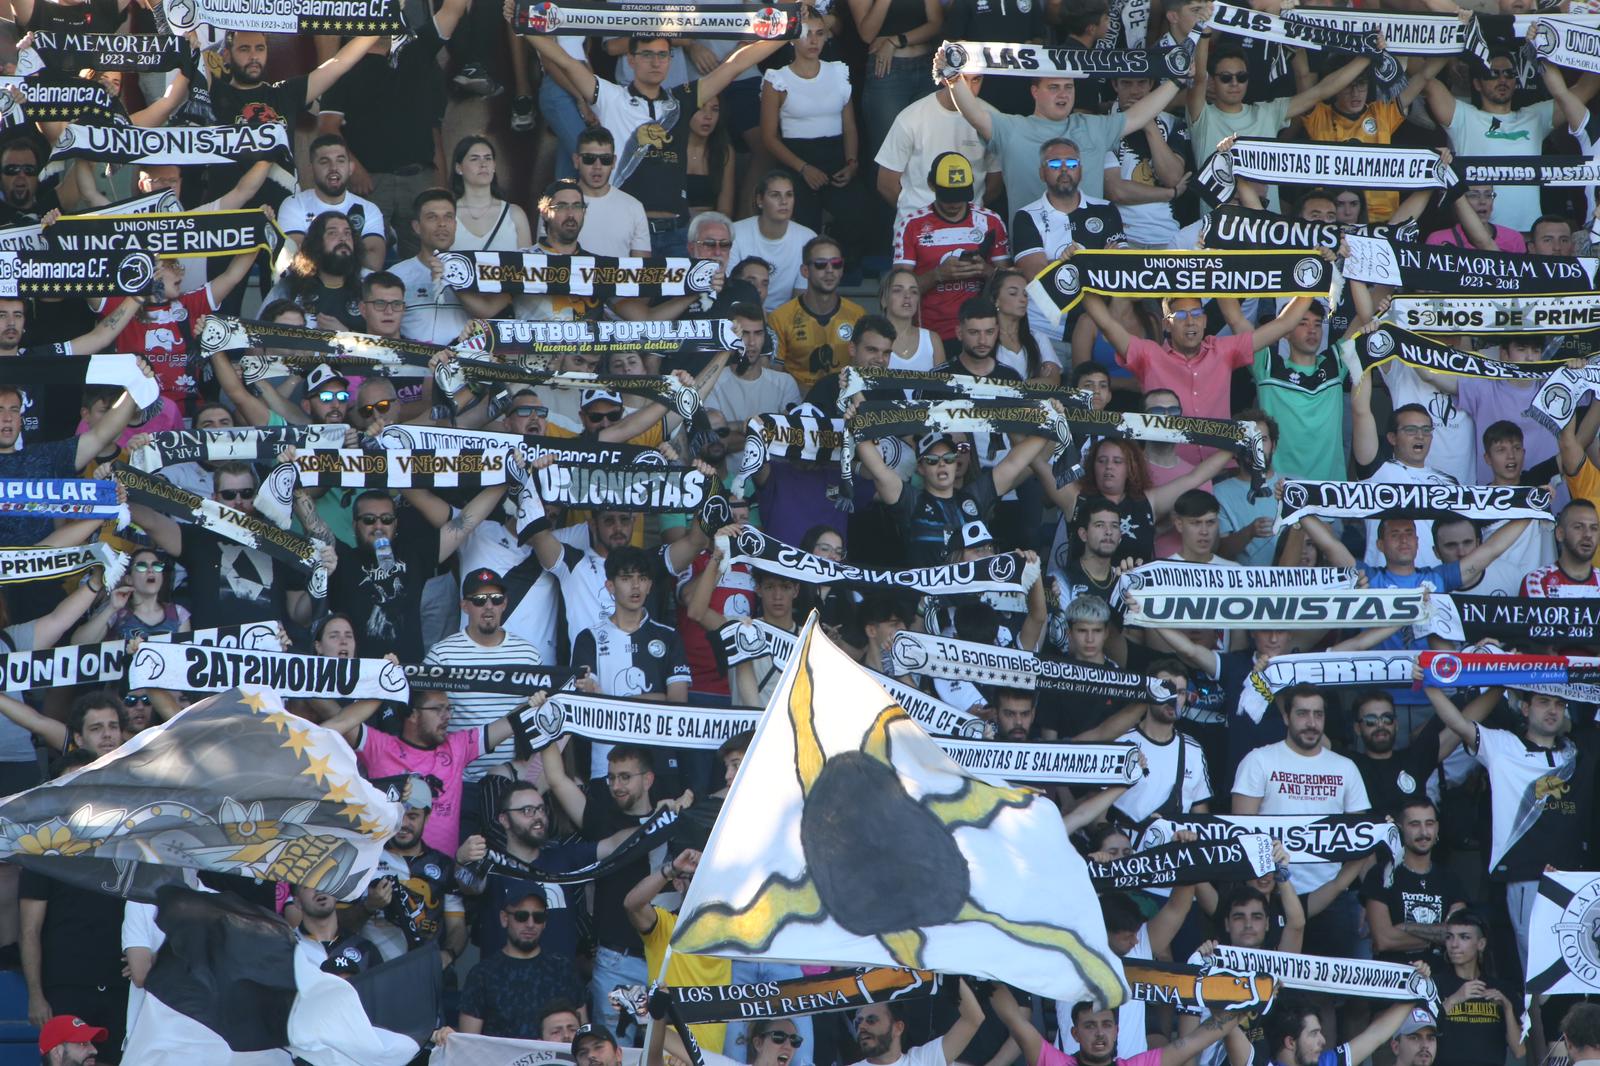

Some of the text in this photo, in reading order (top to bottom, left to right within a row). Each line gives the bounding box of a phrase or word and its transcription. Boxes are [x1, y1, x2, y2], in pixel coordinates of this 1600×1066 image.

[566, 14, 752, 29] UNION DEPORTIVA SALAMANCA
[1213, 5, 1272, 33] LAS
[1440, 25, 1457, 43] CF
[983, 47, 1149, 72] LAS VILLAS
[20, 82, 93, 104] Salamanca
[87, 124, 278, 154] UNIONISTAS
[1240, 149, 1425, 178] UNIONISTAS DE SALAMANCA CF
[1465, 165, 1537, 181] CONTIGO
[1540, 166, 1595, 181] HASTA
[113, 218, 195, 232] UNIONISTAS
[146, 231, 171, 250] SE
[174, 227, 256, 249] RINDE
[12, 257, 86, 280] Salamanca
[88, 257, 111, 279] C.F.
[1143, 257, 1223, 269] UNIONISTAS
[1541, 260, 1583, 279] VDS
[478, 265, 571, 285] KOMANDO
[1087, 269, 1282, 290] NUNCA SE RINDE
[1459, 274, 1520, 290] 1923 2013
[1495, 310, 1523, 326] DE
[497, 320, 713, 343] FUTBOL POPULAR
[533, 340, 680, 353] Nacemos de un mismo destino
[1400, 342, 1481, 375] NUNCA
[297, 452, 388, 475] KOMANDO
[539, 466, 705, 510] UNIONISTAS
[1152, 567, 1336, 589] UNIONISTAS DE SALAMANCA CF
[1142, 595, 1424, 622] UNIONISTAS
[1529, 626, 1594, 638] 1923 2013
[447, 667, 506, 683] HUBO
[510, 670, 553, 689] UNA
[1466, 661, 1481, 672] III
[1485, 661, 1565, 673] MEMORIAL
[573, 708, 652, 735] UNIONISTAS
[656, 715, 672, 736] DE
[935, 712, 957, 732] CF
[1014, 751, 1030, 771] DE
[1033, 752, 1099, 774] SALAMANCA
[1102, 756, 1118, 774] CF
[1270, 770, 1344, 787] ABERCROMBIE
[1278, 782, 1337, 798] AND FITCH
[1198, 843, 1243, 866] VDS
[1114, 870, 1177, 888] 1923 2013
[1241, 953, 1311, 980] SALAMANCA
[1314, 961, 1329, 981] DE
[1332, 963, 1402, 988] UNIONISTAS
[677, 980, 781, 1003] LOS LOCOS
[739, 999, 777, 1018] DEL
